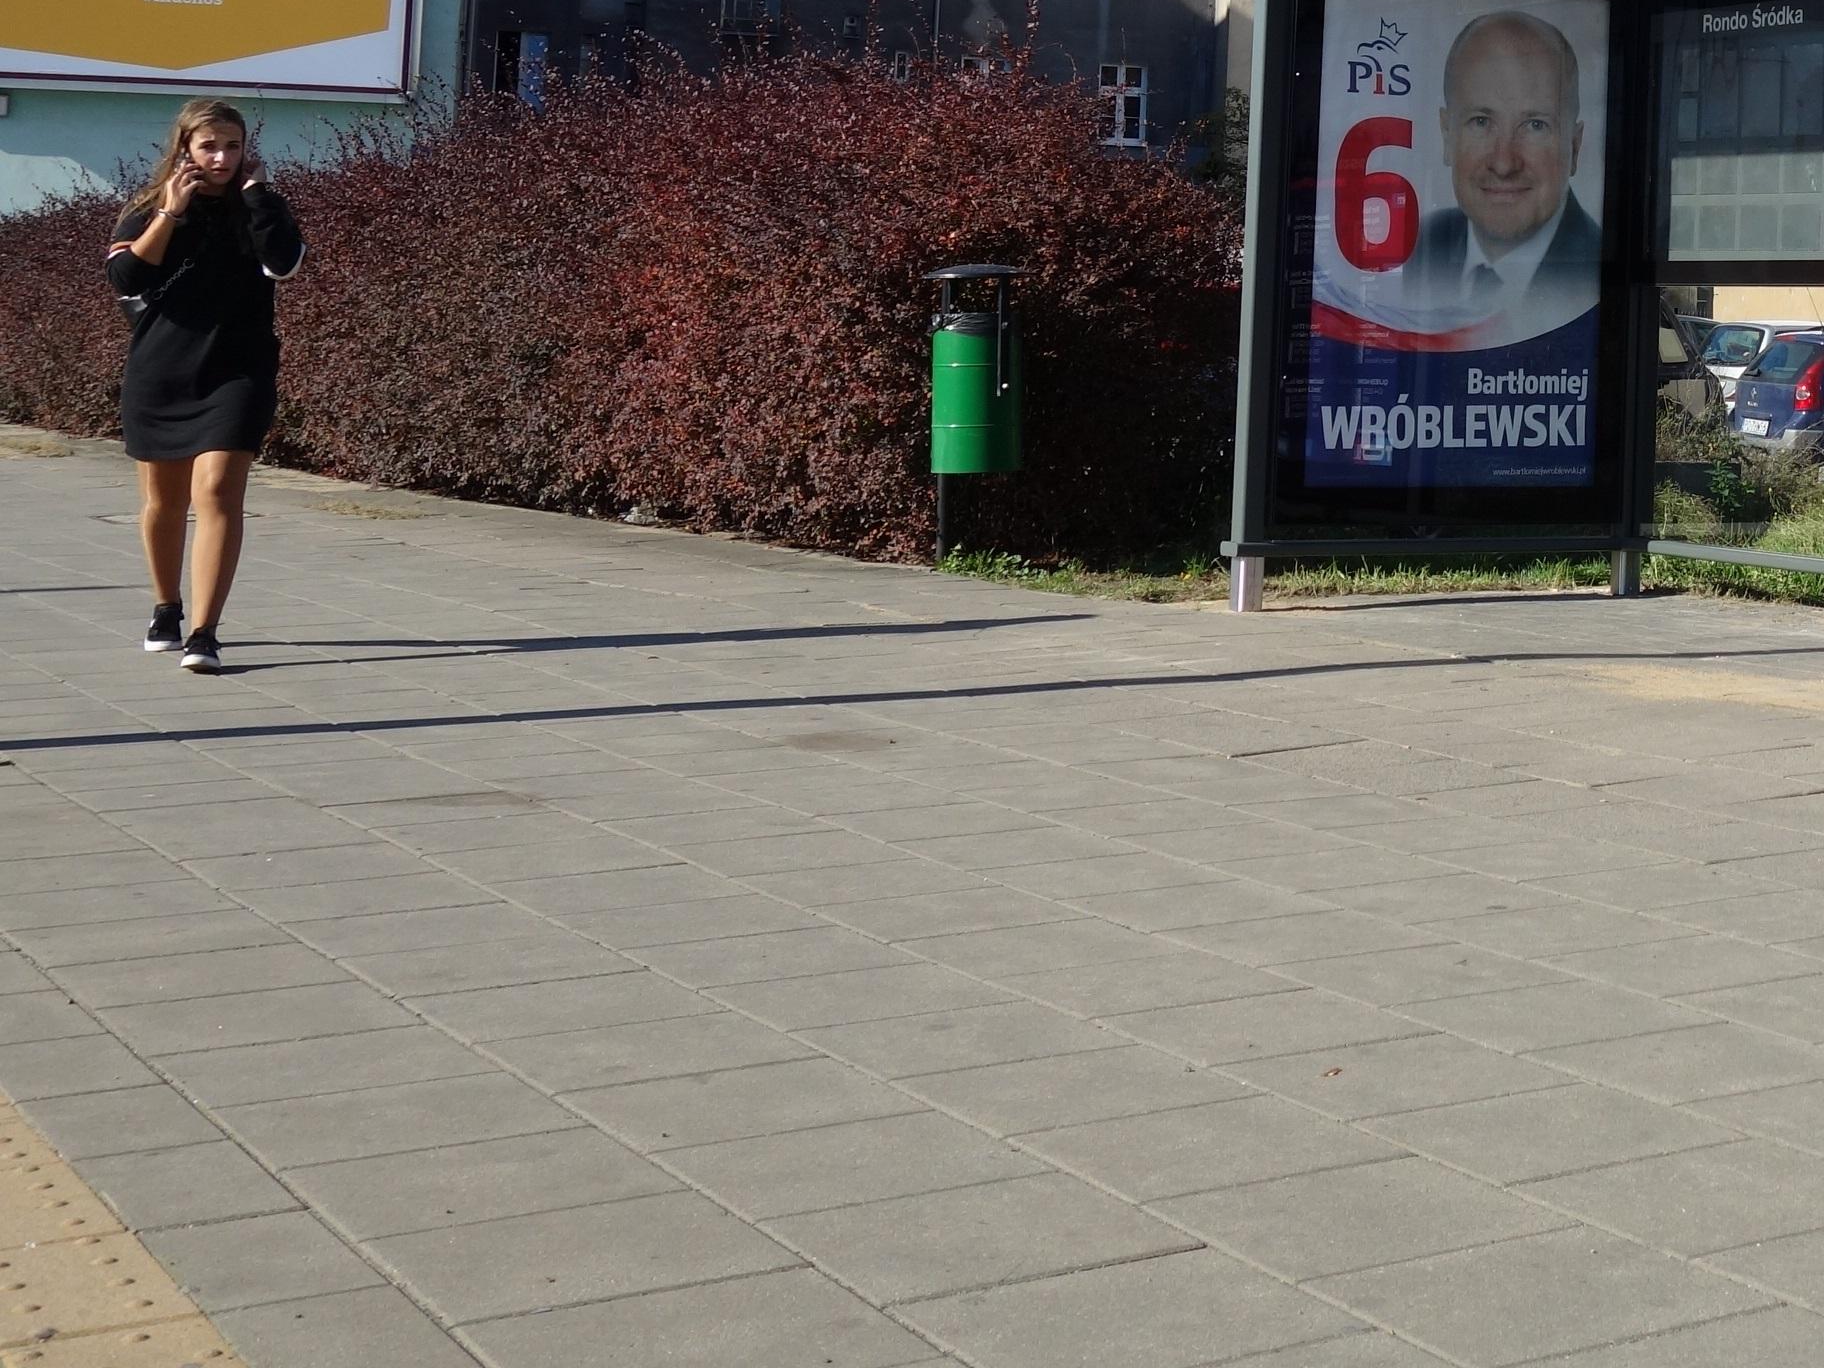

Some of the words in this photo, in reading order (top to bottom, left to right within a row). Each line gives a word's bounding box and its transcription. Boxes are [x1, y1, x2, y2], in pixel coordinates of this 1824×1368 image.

[1703, 14, 1748, 34] Rondo
[1752, 3, 1804, 28] Śródka
[1346, 60, 1411, 96] PiS
[1334, 114, 1421, 273] 6
[1467, 368, 1589, 401] Bartłomiej
[1320, 394, 1587, 450] WRÓBLEWSKI
